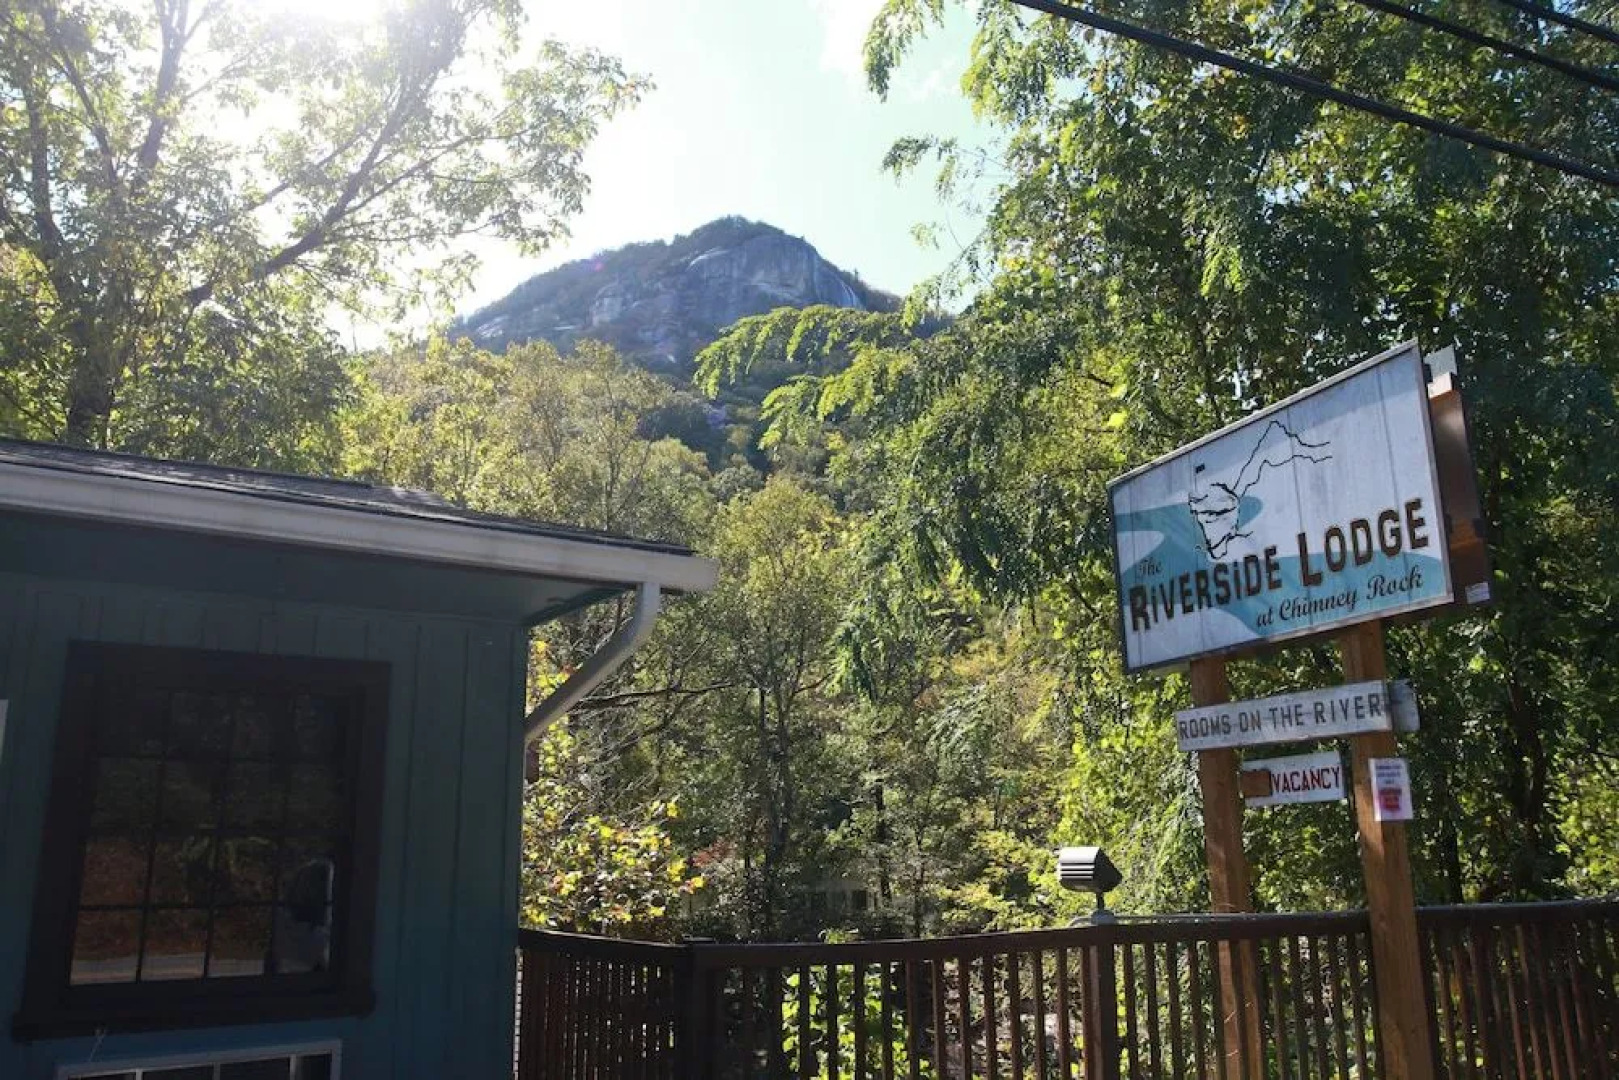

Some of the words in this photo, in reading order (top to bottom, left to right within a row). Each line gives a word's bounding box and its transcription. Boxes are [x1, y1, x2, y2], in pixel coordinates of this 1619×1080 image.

[1296, 497, 1429, 587] LODGE
[1137, 558, 1162, 578] The
[1256, 604, 1274, 628] at
[1278, 591, 1359, 622] Chimney
[1366, 565, 1424, 601] Rock
[1179, 717, 1231, 739] ROOMS
[1239, 710, 1261, 732] ON
[1269, 703, 1305, 728] THE
[1313, 693, 1382, 724] RIVER
[1271, 766, 1340, 793] VACANCY
